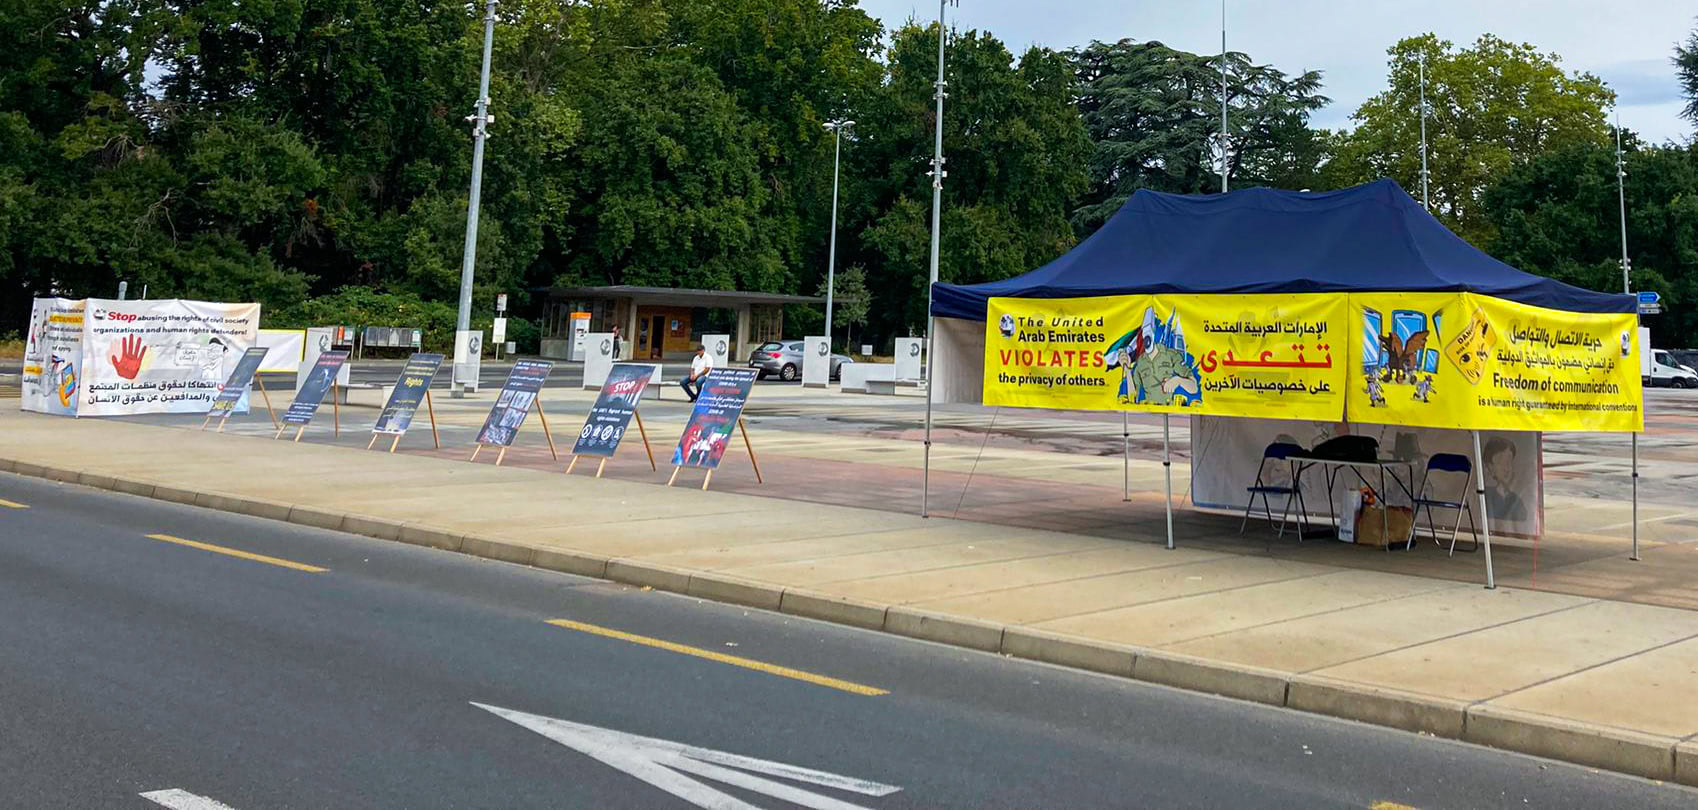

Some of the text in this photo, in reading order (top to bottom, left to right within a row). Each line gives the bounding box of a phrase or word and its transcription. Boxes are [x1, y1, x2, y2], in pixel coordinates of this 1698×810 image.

[107, 311, 137, 323] Stop
[137, 314, 167, 322] abusing
[182, 314, 201, 323] rights
[1018, 316, 1104, 327] The United
[93, 326, 144, 335] organizations
[189, 327, 209, 335] rights
[1018, 330, 1105, 342] Arab Emirates
[1204, 320, 1327, 340] الإمارات العربية المتحدة
[1509, 325, 1602, 352] حرية الاتصال والتواصل
[1000, 349, 1104, 368] VIOLATES
[1200, 344, 1332, 373] تتعدى
[1496, 349, 1523, 367] الدولية
[1526, 350, 1556, 369] بالمواثيق
[1557, 355, 1583, 371] مضمون
[158, 381, 187, 391] لحقوق
[614, 380, 636, 393] STOP
[999, 372, 1105, 387] the privacy of others
[1204, 375, 1330, 395] على خصوصيات الآخرين
[1493, 372, 1619, 394] Freedom of communication
[88, 383, 119, 393] المجتمع
[121, 383, 157, 391] منظمات
[122, 395, 145, 405] حقوق
[147, 394, 158, 402] عن
[161, 391, 210, 403] والمدافعين
[1479, 396, 1486, 406] is
[1490, 397, 1510, 408] human
[1512, 398, 1525, 411] right
[1526, 400, 1560, 411] guaranteed
[1561, 401, 1568, 413] by
[1568, 401, 1601, 411] international
[1602, 402, 1637, 412] conventions
